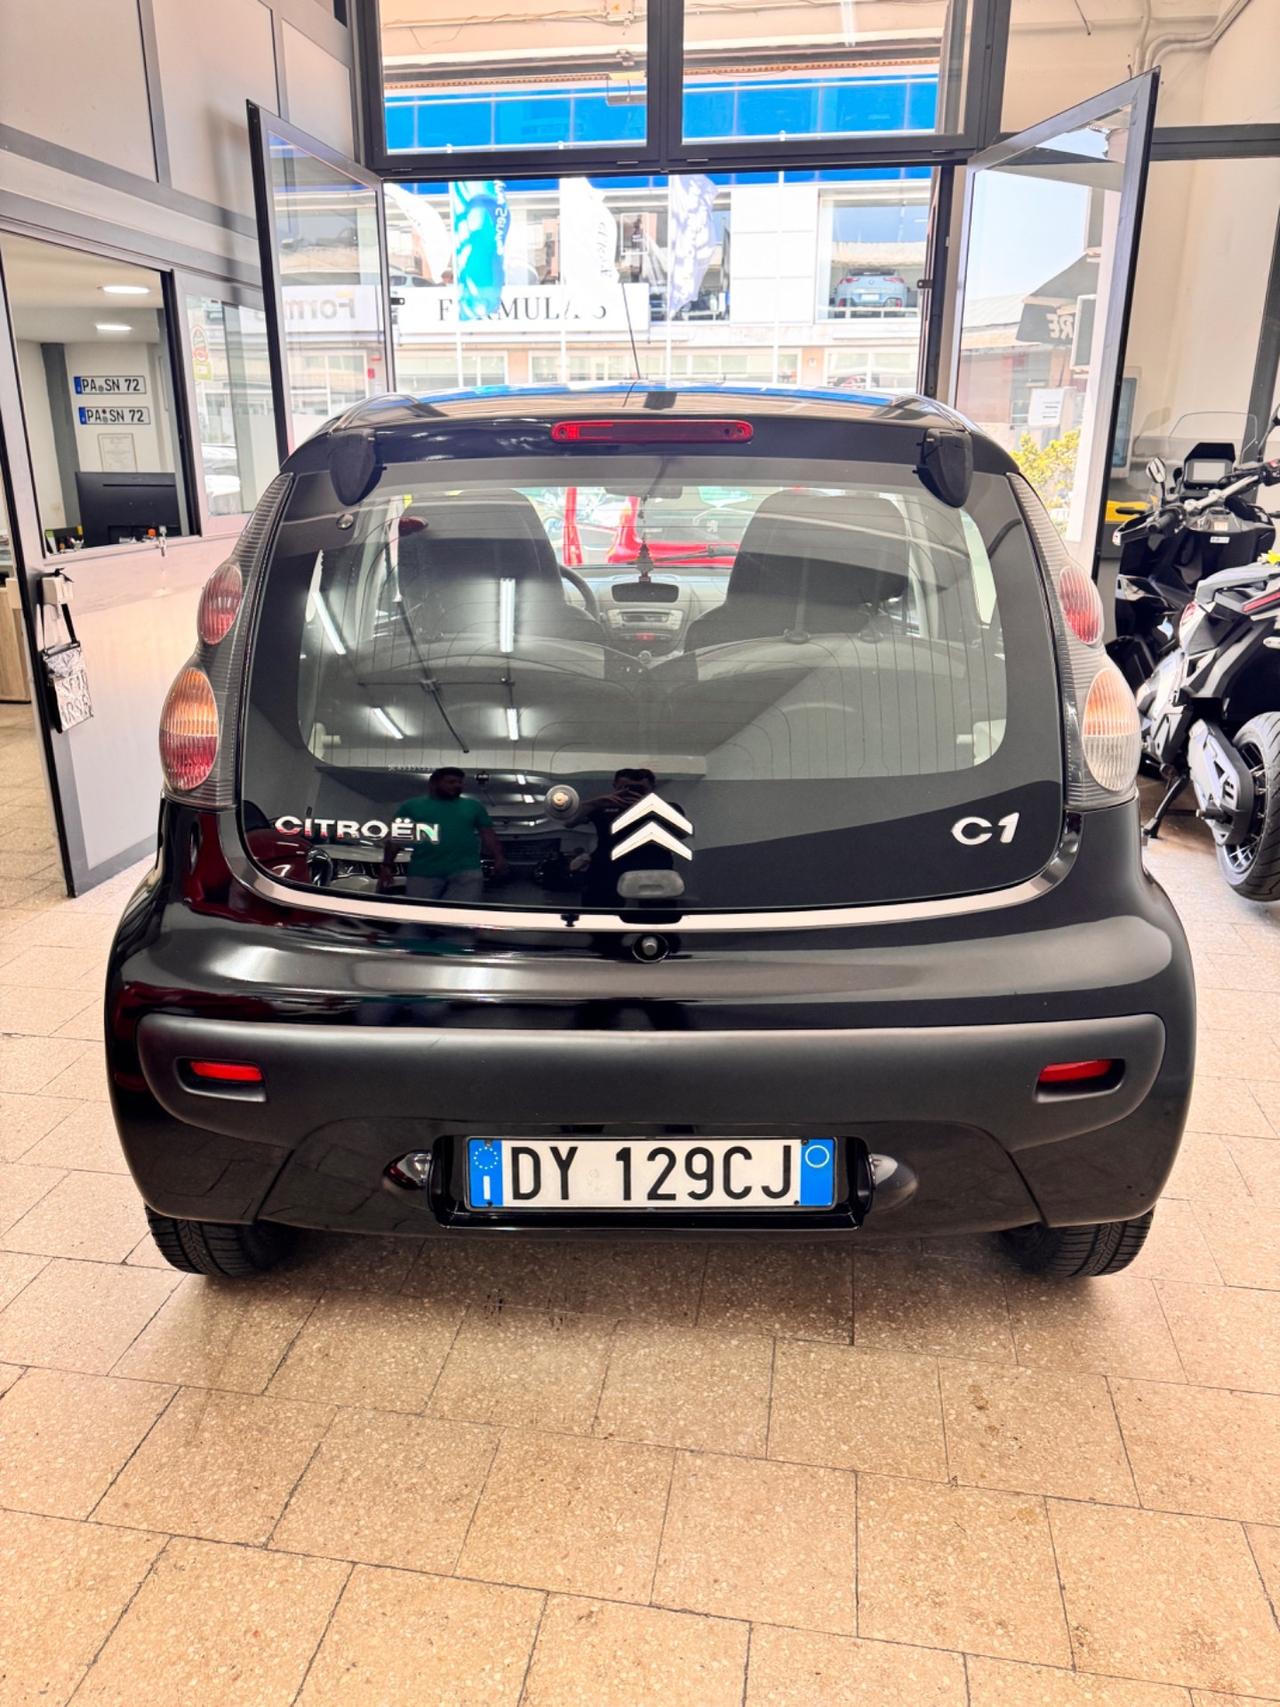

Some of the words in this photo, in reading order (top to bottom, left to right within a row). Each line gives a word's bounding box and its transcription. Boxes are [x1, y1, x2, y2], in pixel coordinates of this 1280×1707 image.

[438, 296, 581, 321] FMUL
[82, 378, 97, 392] PA
[105, 378, 120, 392] SN
[125, 378, 140, 392] 72
[86, 409, 102, 423] PA
[109, 409, 125, 423] SN
[129, 409, 144, 423] 72
[274, 814, 440, 844] CITROËN
[951, 812, 1020, 846] C1
[511, 1145, 579, 1201] DY
[616, 1145, 792, 1201] 129CJ
